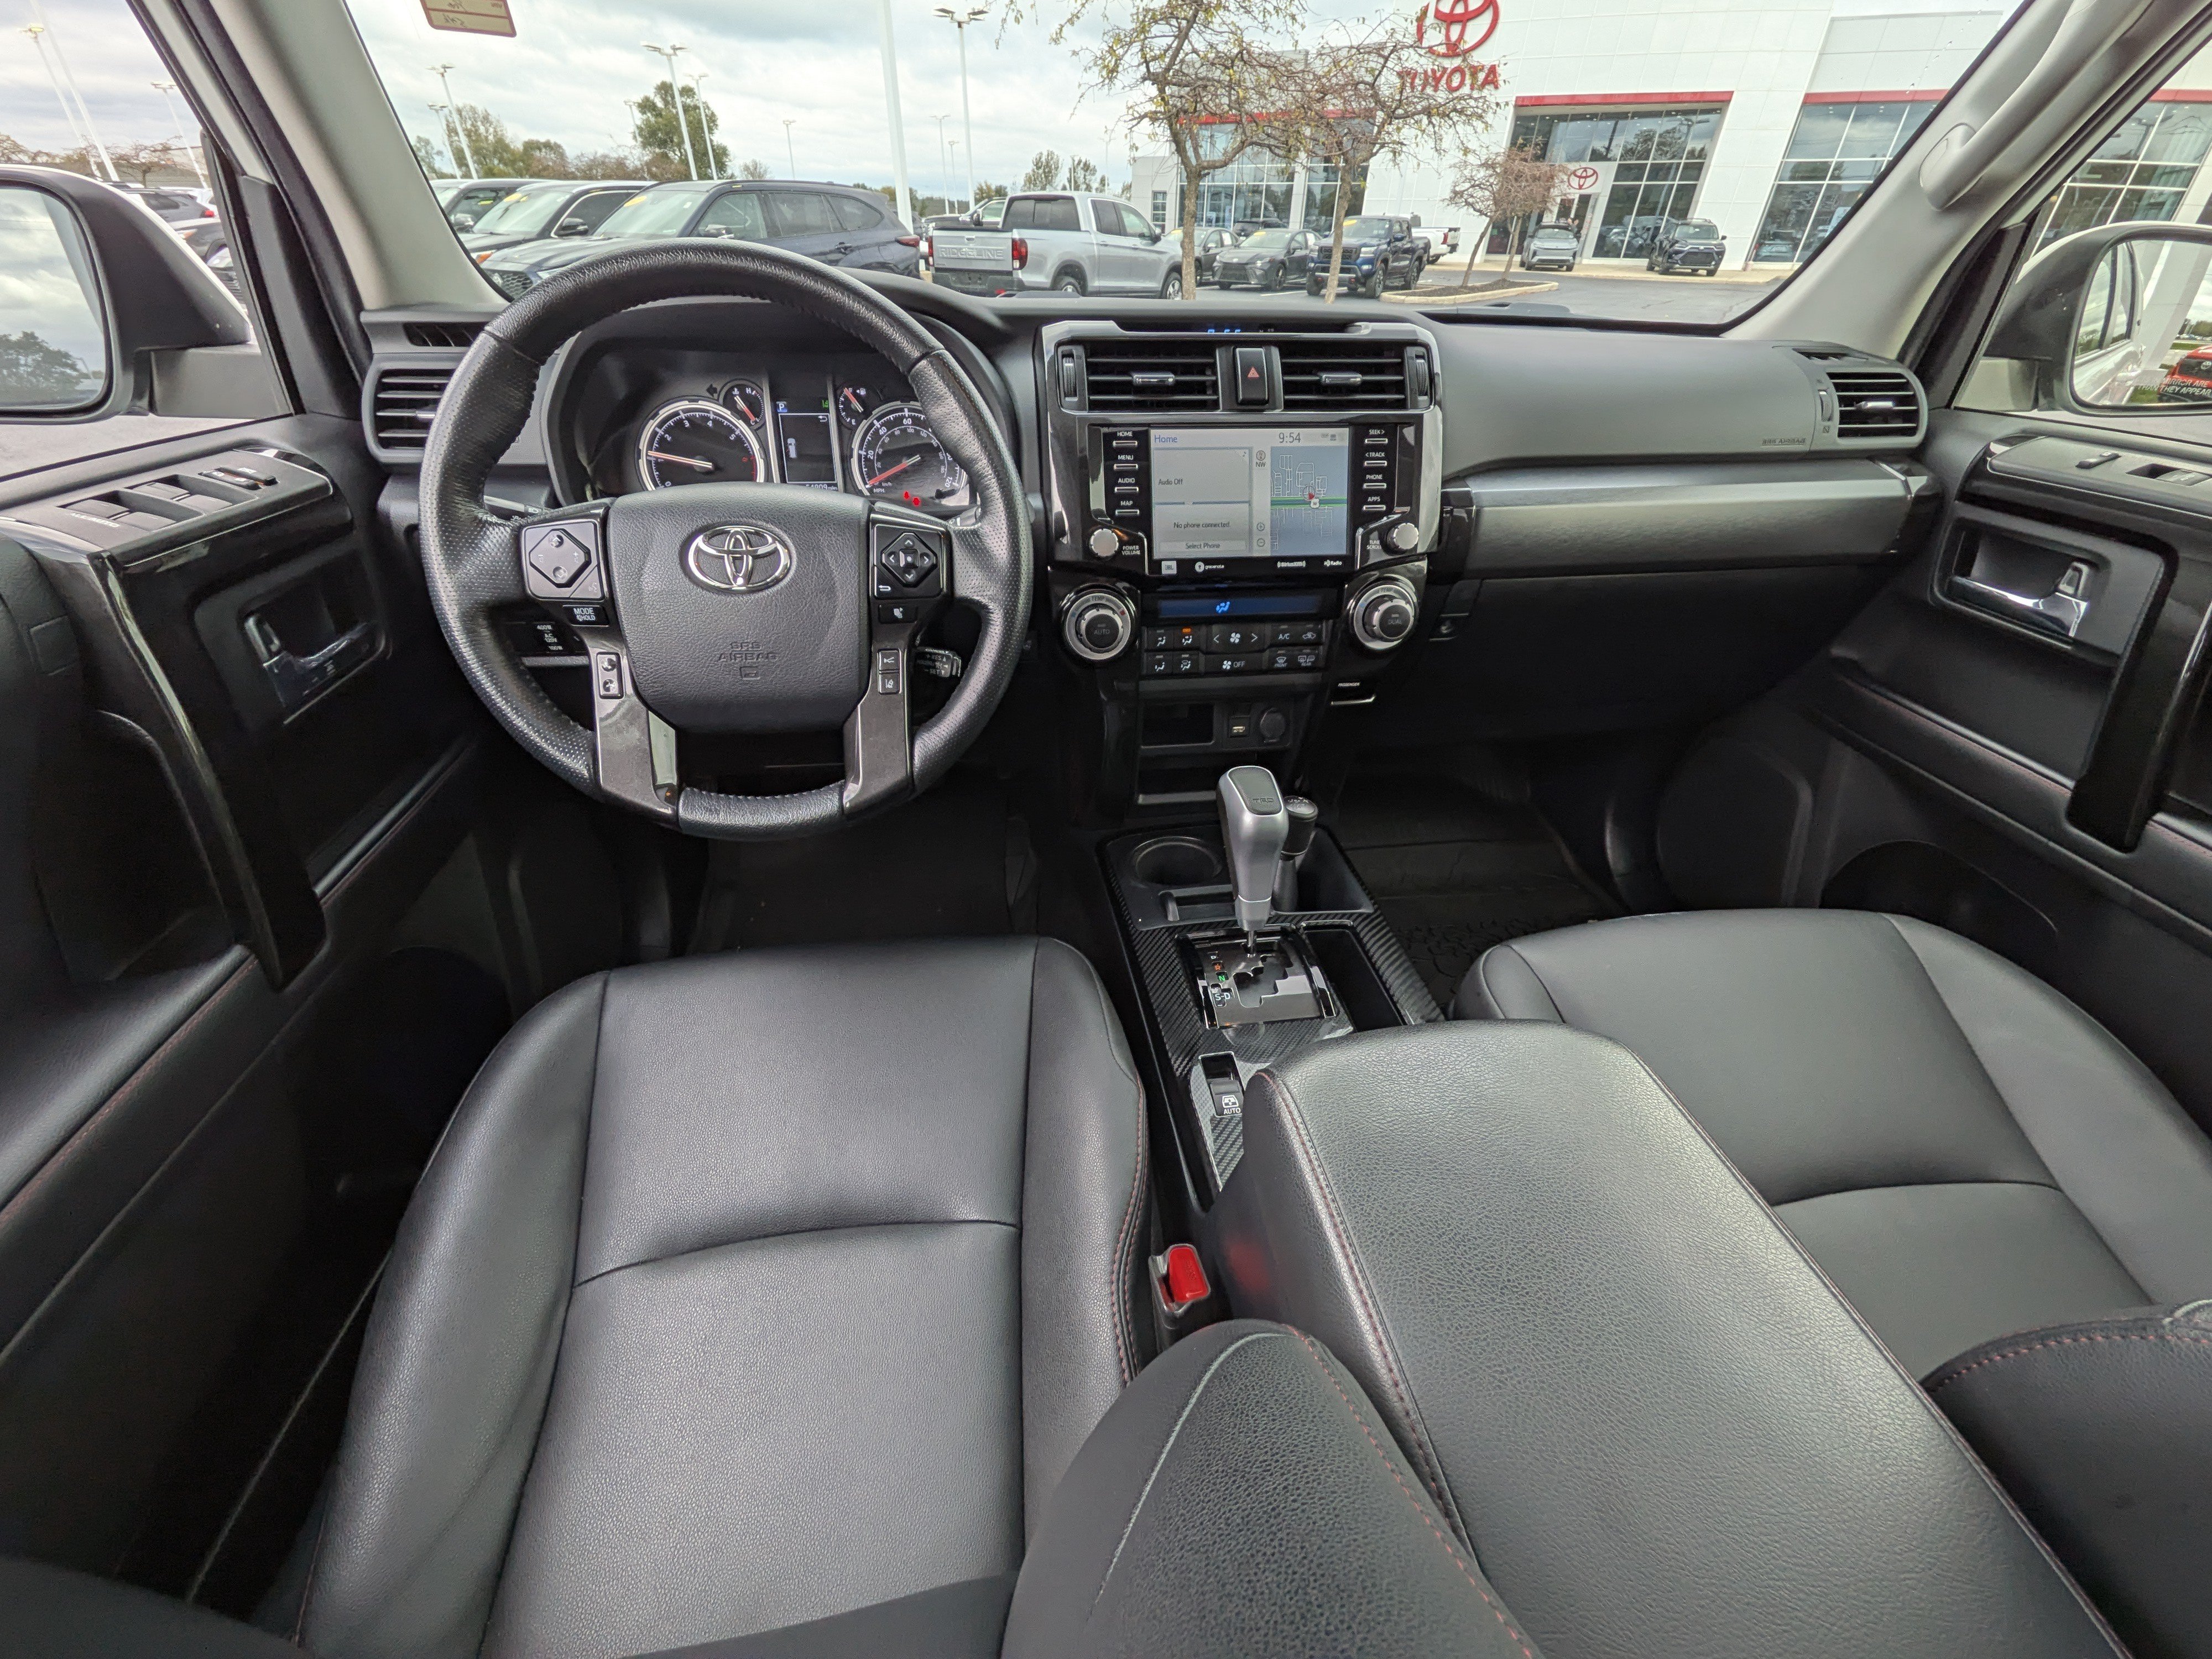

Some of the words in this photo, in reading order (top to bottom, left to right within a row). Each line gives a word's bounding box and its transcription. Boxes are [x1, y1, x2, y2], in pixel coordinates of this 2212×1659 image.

[1397, 64, 1499, 92] TOYOTA
[939, 248, 1004, 259] RIDGELINE
[684, 420, 690, 428] 3
[707, 419, 713, 428] 4
[878, 426, 888, 436] 40
[1154, 435, 1178, 443] Home
[1279, 432, 1301, 444] 9:54
[867, 450, 874, 460] 20
[944, 476, 953, 488] 120
